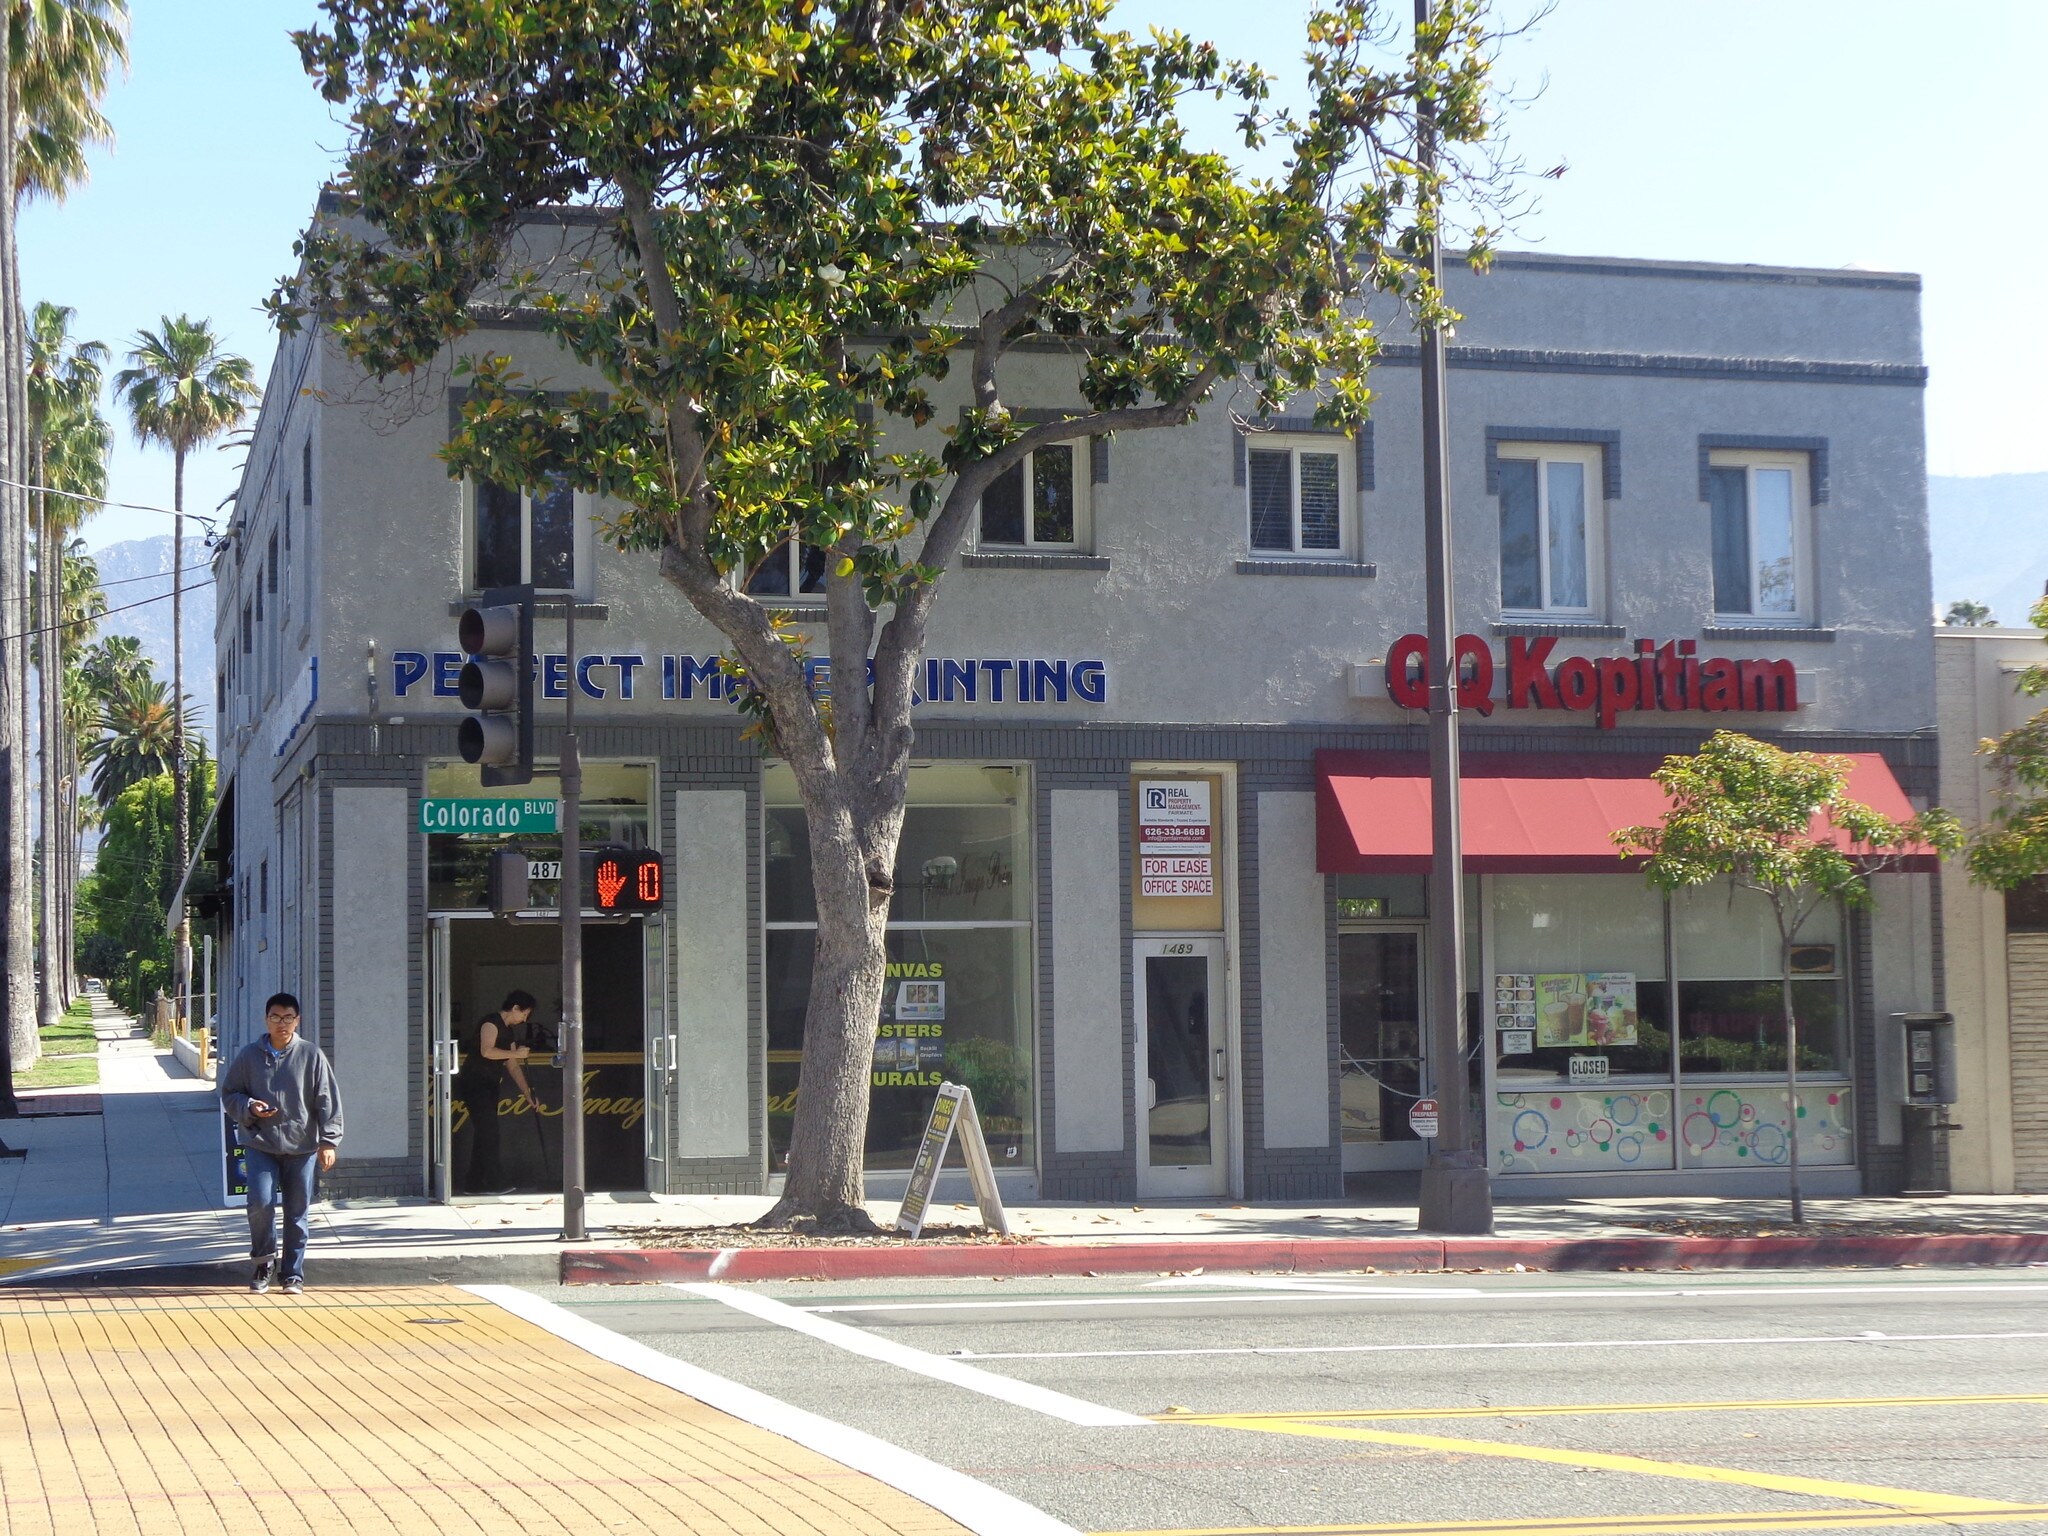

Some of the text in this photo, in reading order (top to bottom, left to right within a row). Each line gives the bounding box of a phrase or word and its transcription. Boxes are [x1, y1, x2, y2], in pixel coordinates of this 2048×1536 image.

[391, 651, 1107, 708] PEECT IME INTING
[1385, 633, 1798, 729] QQ Kopitiam
[1168, 788, 1189, 798] REAL
[423, 801, 554, 827] Colorado BLVD
[1145, 828, 1206, 836] 626-338-6688
[531, 862, 560, 878] 487
[1145, 860, 1208, 873] FOR LEASE
[1144, 880, 1212, 893] OFFICE SPACE
[1162, 943, 1193, 954] 1489
[886, 963, 943, 978] NVAS
[1572, 1060, 1607, 1075] CLOSED
[872, 1072, 943, 1086] URALS
[1422, 1103, 1433, 1111] NO
